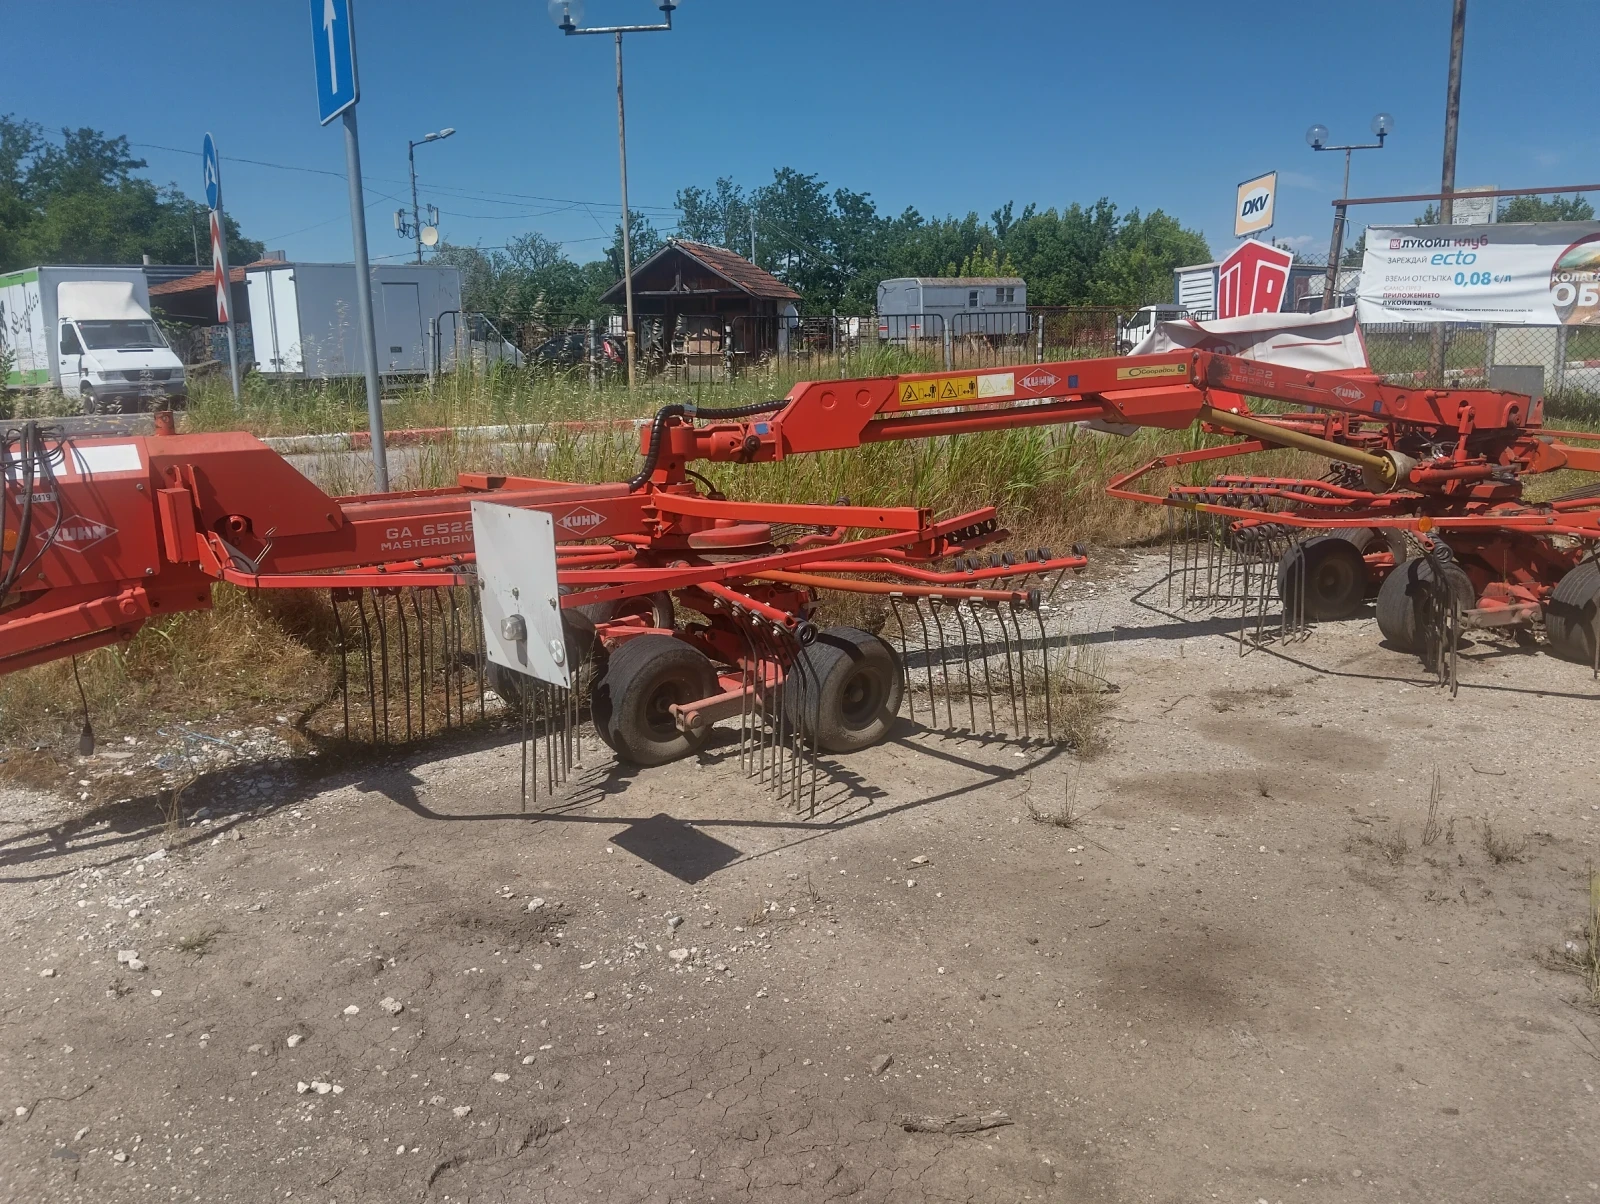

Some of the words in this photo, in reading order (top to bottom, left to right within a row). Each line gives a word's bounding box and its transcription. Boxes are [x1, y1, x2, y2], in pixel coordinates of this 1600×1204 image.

[1242, 193, 1270, 217] DKV
[1401, 238, 1450, 249] ЛУКОЙЛ
[1454, 234, 1489, 250] клуб
[1387, 256, 1428, 265] ЗАРЕЖДАЙ
[1431, 250, 1477, 266] ecto
[1385, 275, 1411, 283] ВЗЕМИ
[1411, 275, 1452, 283] ОТСТЪПКА
[1454, 271, 1492, 287] 0,08
[1239, 365, 1274, 379] 6522
[1023, 375, 1055, 388] KUHN
[1224, 373, 1276, 388] STERDRIVE
[1335, 386, 1362, 399] KUHN
[563, 514, 600, 528] KUHN
[47, 525, 107, 542] KUHN
[386, 526, 413, 540] GA
[422, 521, 474, 536] 6522
[380, 533, 474, 551] MASTERDRIV
